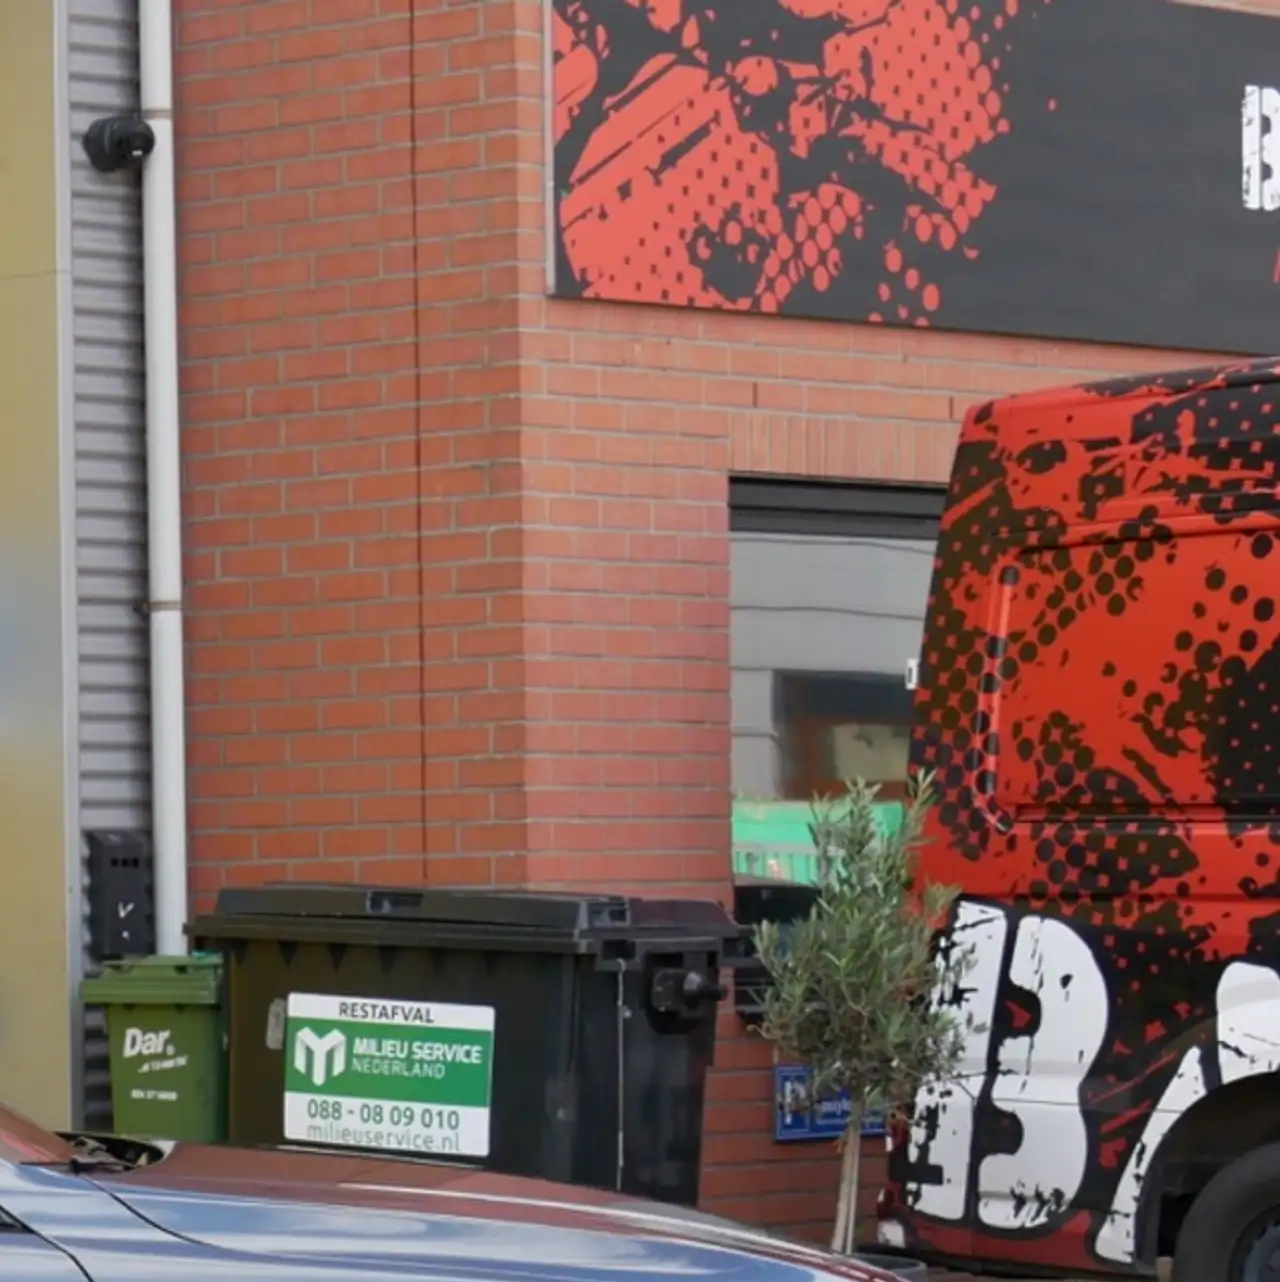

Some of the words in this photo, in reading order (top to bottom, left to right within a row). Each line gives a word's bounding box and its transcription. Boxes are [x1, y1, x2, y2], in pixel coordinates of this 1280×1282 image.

[339, 1002, 435, 1024] RESTAFVAL
[352, 1037, 409, 1059] MILIEU
[411, 1041, 483, 1064] SERVICE
[352, 1058, 446, 1079] NEDERLAND
[307, 1098, 342, 1121] 088
[359, 1103, 384, 1124] 08
[389, 1106, 415, 1126] 09
[421, 1108, 461, 1130] 010
[307, 1123, 461, 1151] milieuservice.nl
